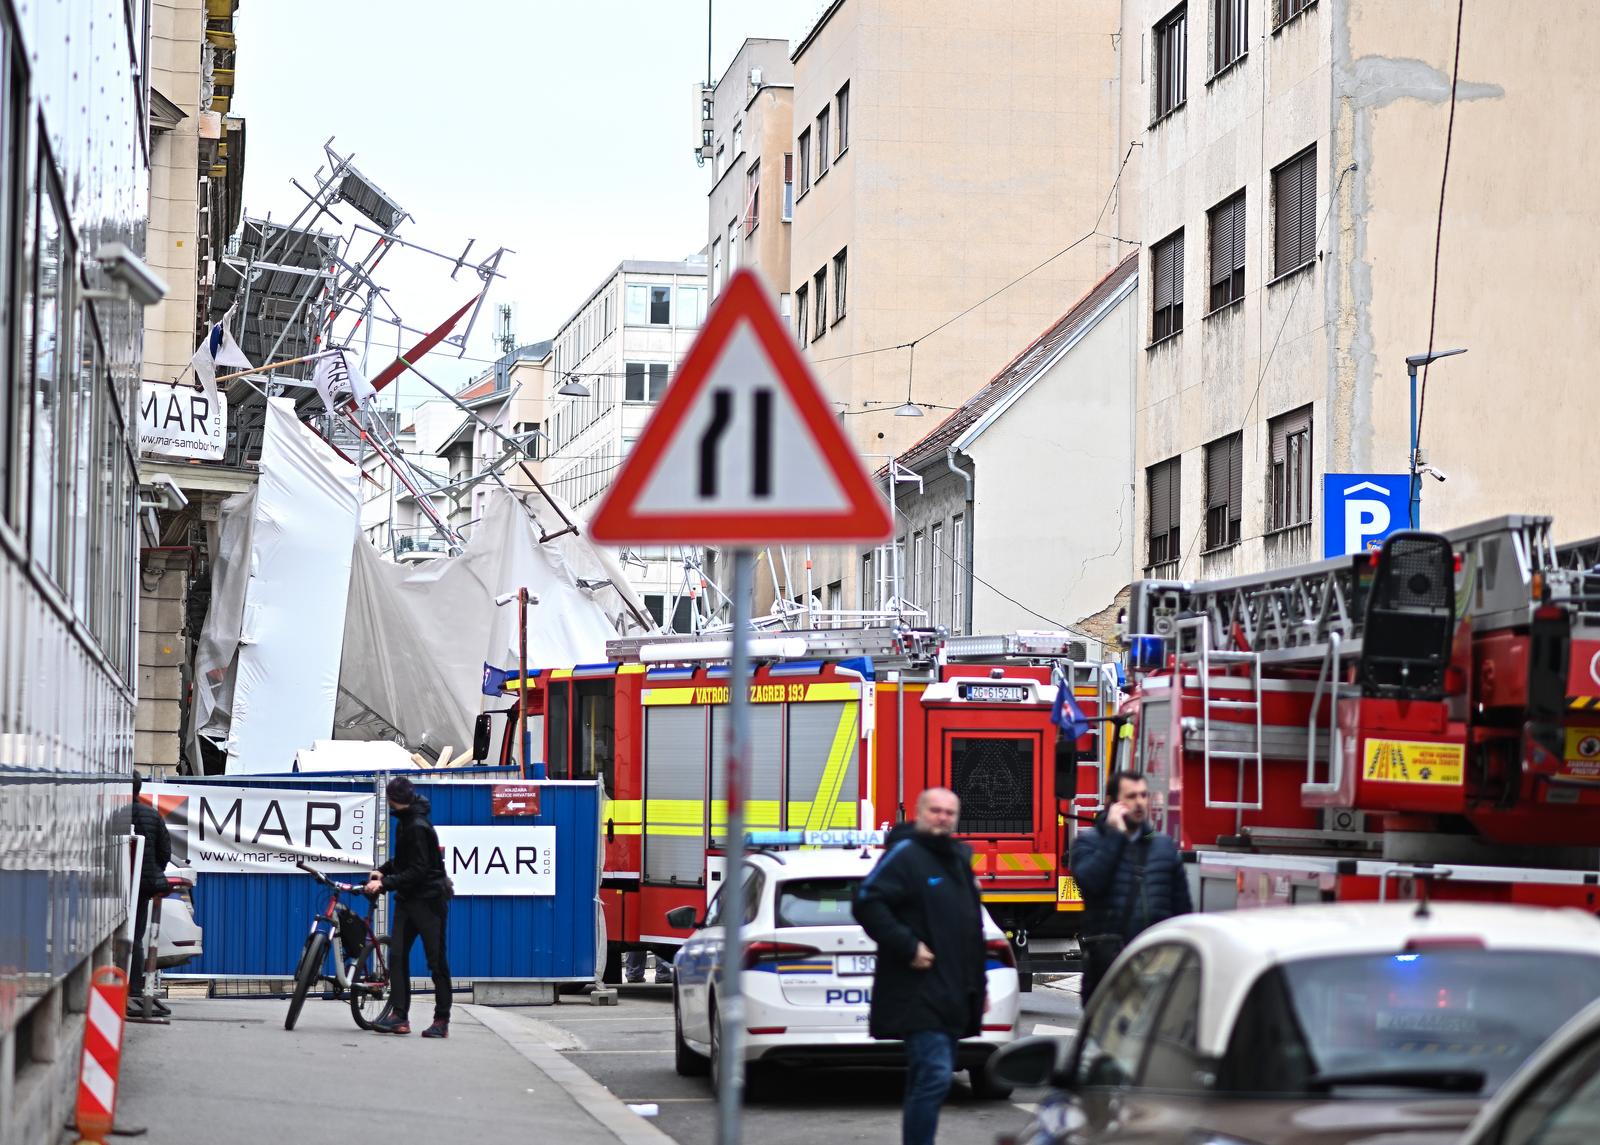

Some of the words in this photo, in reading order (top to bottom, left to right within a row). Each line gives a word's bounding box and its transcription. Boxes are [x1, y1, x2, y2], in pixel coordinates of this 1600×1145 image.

[1344, 499, 1391, 555] P
[695, 686, 747, 704] VATROG
[750, 684, 785, 703] ZAGREB
[788, 683, 804, 702] 193
[973, 687, 983, 698] ZG
[199, 796, 342, 850] MAR
[810, 831, 880, 844] POLICIJA
[452, 846, 538, 875] MAR
[852, 956, 877, 971] 190
[826, 989, 873, 1004] POL
